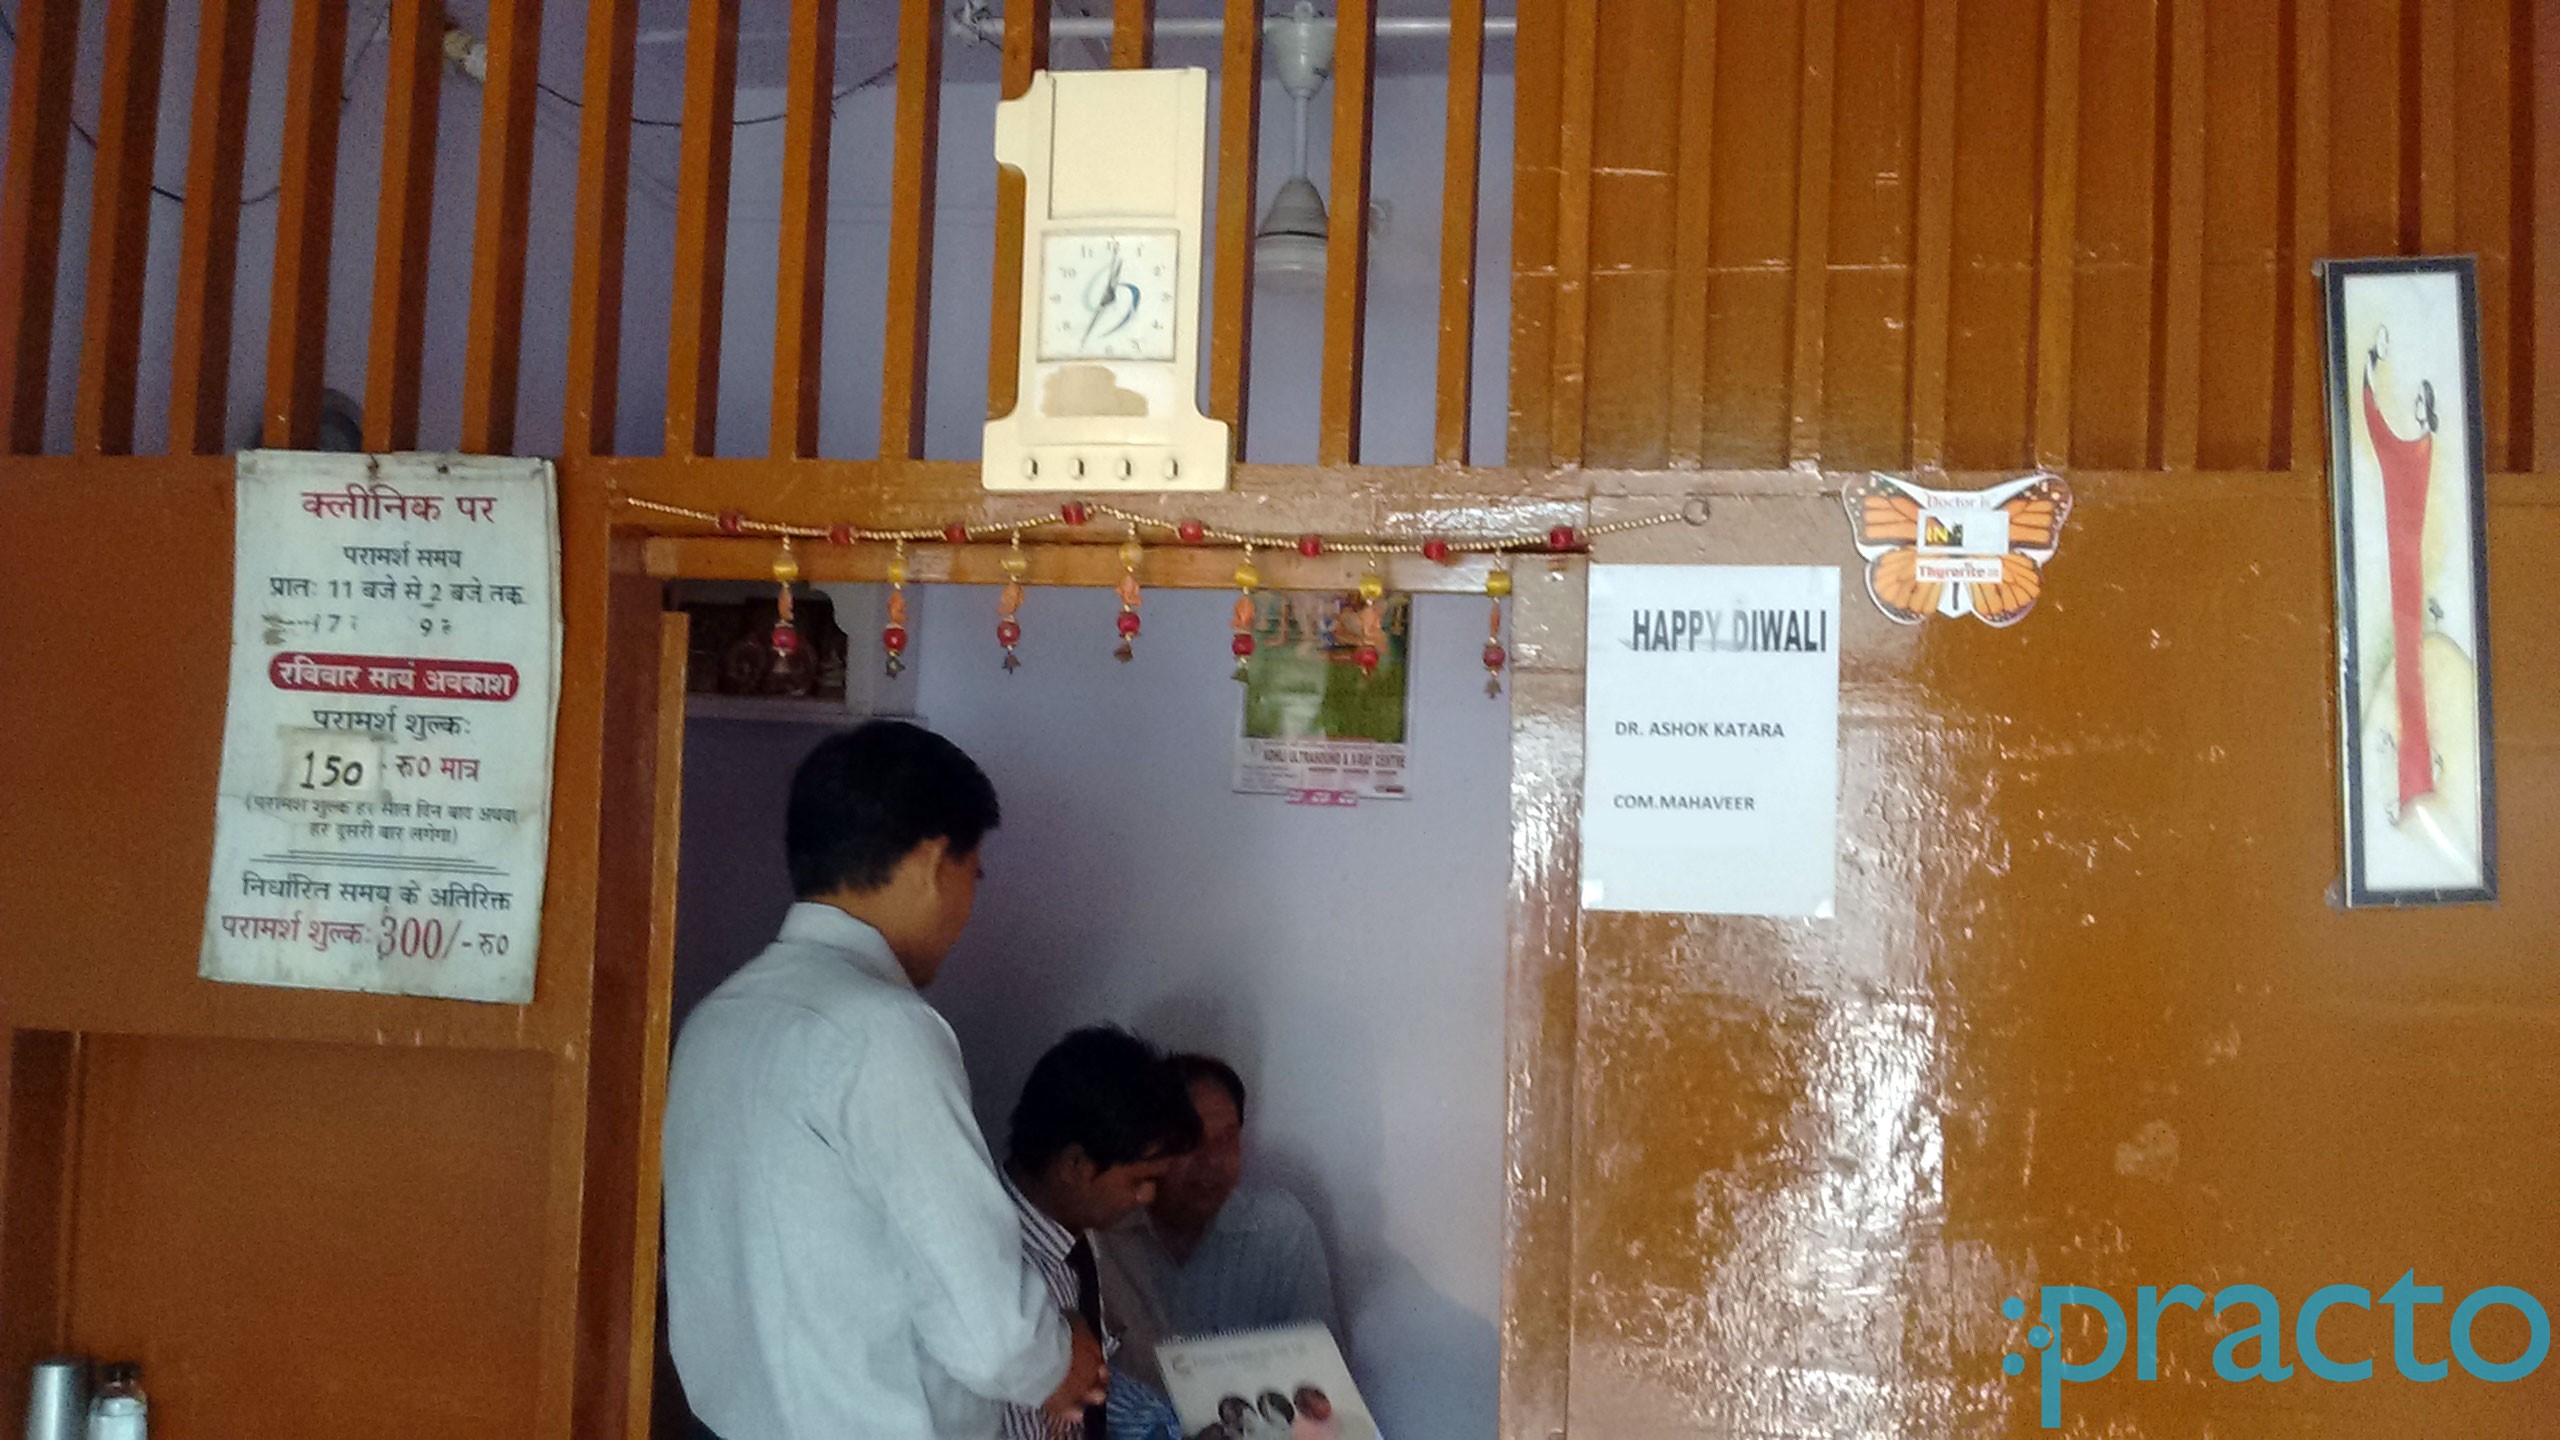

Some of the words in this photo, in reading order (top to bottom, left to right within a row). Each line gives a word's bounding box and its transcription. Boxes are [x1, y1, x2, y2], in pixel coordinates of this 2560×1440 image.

[301, 484, 444, 523] क्लीनिक
[455, 496, 498, 524] पर
[343, 541, 411, 569] परामर्श
[416, 549, 463, 569] समय
[328, 580, 351, 599] 11
[361, 574, 399, 601] बजे
[404, 575, 423, 600] से
[429, 582, 443, 603] 2
[450, 577, 484, 604] बजे
[489, 583, 526, 606] तक
[1632, 609, 1722, 653] HAPPY
[1732, 609, 1827, 653] DIWALI
[277, 655, 361, 689] रविवार
[422, 669, 514, 697] अवकाश
[314, 707, 398, 733] परामर्श
[1615, 719, 1643, 736] DR.
[1649, 721, 1709, 738] ASHOK
[1713, 722, 1785, 738] KATARA
[299, 749, 365, 791] 150
[439, 757, 480, 782] मात्र
[1614, 794, 1755, 812] COM.MAHAVEER
[339, 882, 391, 903] समय
[400, 880, 422, 904] के
[430, 881, 514, 911] अतिरिक्त
[221, 910, 304, 942] परामर्श
